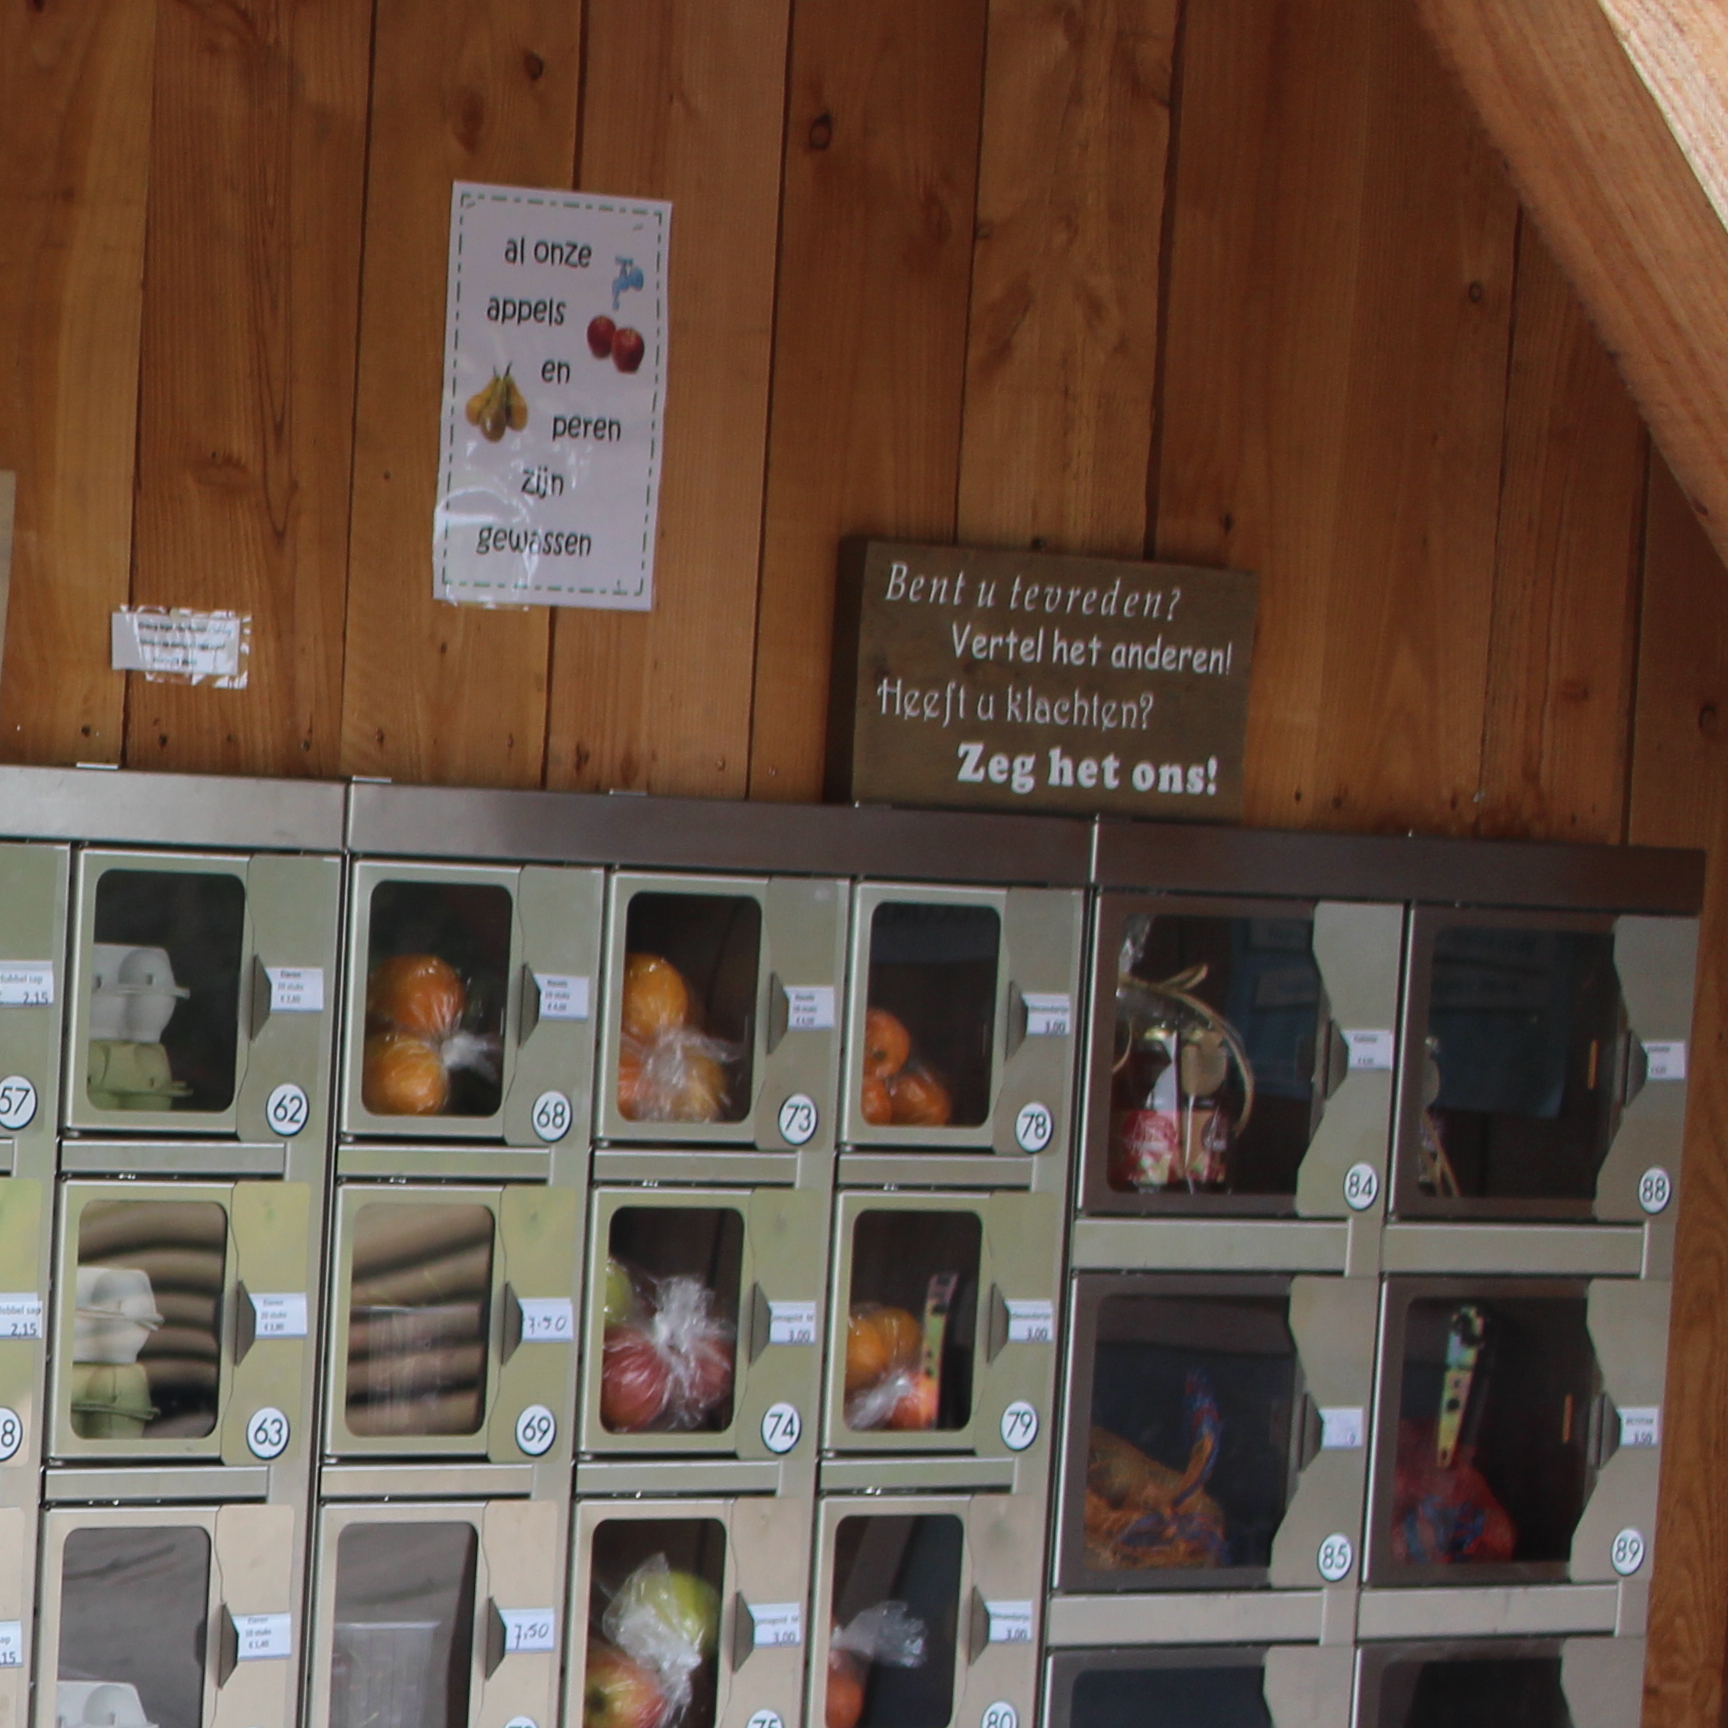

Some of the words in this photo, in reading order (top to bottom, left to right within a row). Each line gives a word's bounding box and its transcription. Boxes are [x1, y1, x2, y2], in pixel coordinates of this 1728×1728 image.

[505, 237, 524, 264] al
[534, 241, 592, 268] onze
[487, 296, 566, 326] appels
[541, 360, 570, 385] en
[552, 415, 621, 442] peren
[521, 466, 564, 498] zijn
[476, 525, 591, 556] gewassen
[885, 561, 966, 606] Bent
[977, 579, 997, 608] u
[1010, 575, 1181, 621] tevreden?
[951, 622, 1043, 663] Vertel
[1052, 627, 1102, 666] het
[1111, 634, 1233, 675] anderen!
[877, 677, 965, 728] Heeft
[977, 692, 994, 721] u
[1007, 685, 1153, 731] klachten?
[957, 742, 1035, 794] Zeg
[1048, 747, 1120, 791] het
[1131, 755, 1218, 796] ons!
[274, 1095, 302, 1123] 62
[537, 1102, 565, 1129] 68
[786, 1105, 811, 1132] 73
[1023, 1113, 1046, 1139] 78
[1348, 1173, 1372, 1197] 84
[1643, 1177, 1665, 1202] 88
